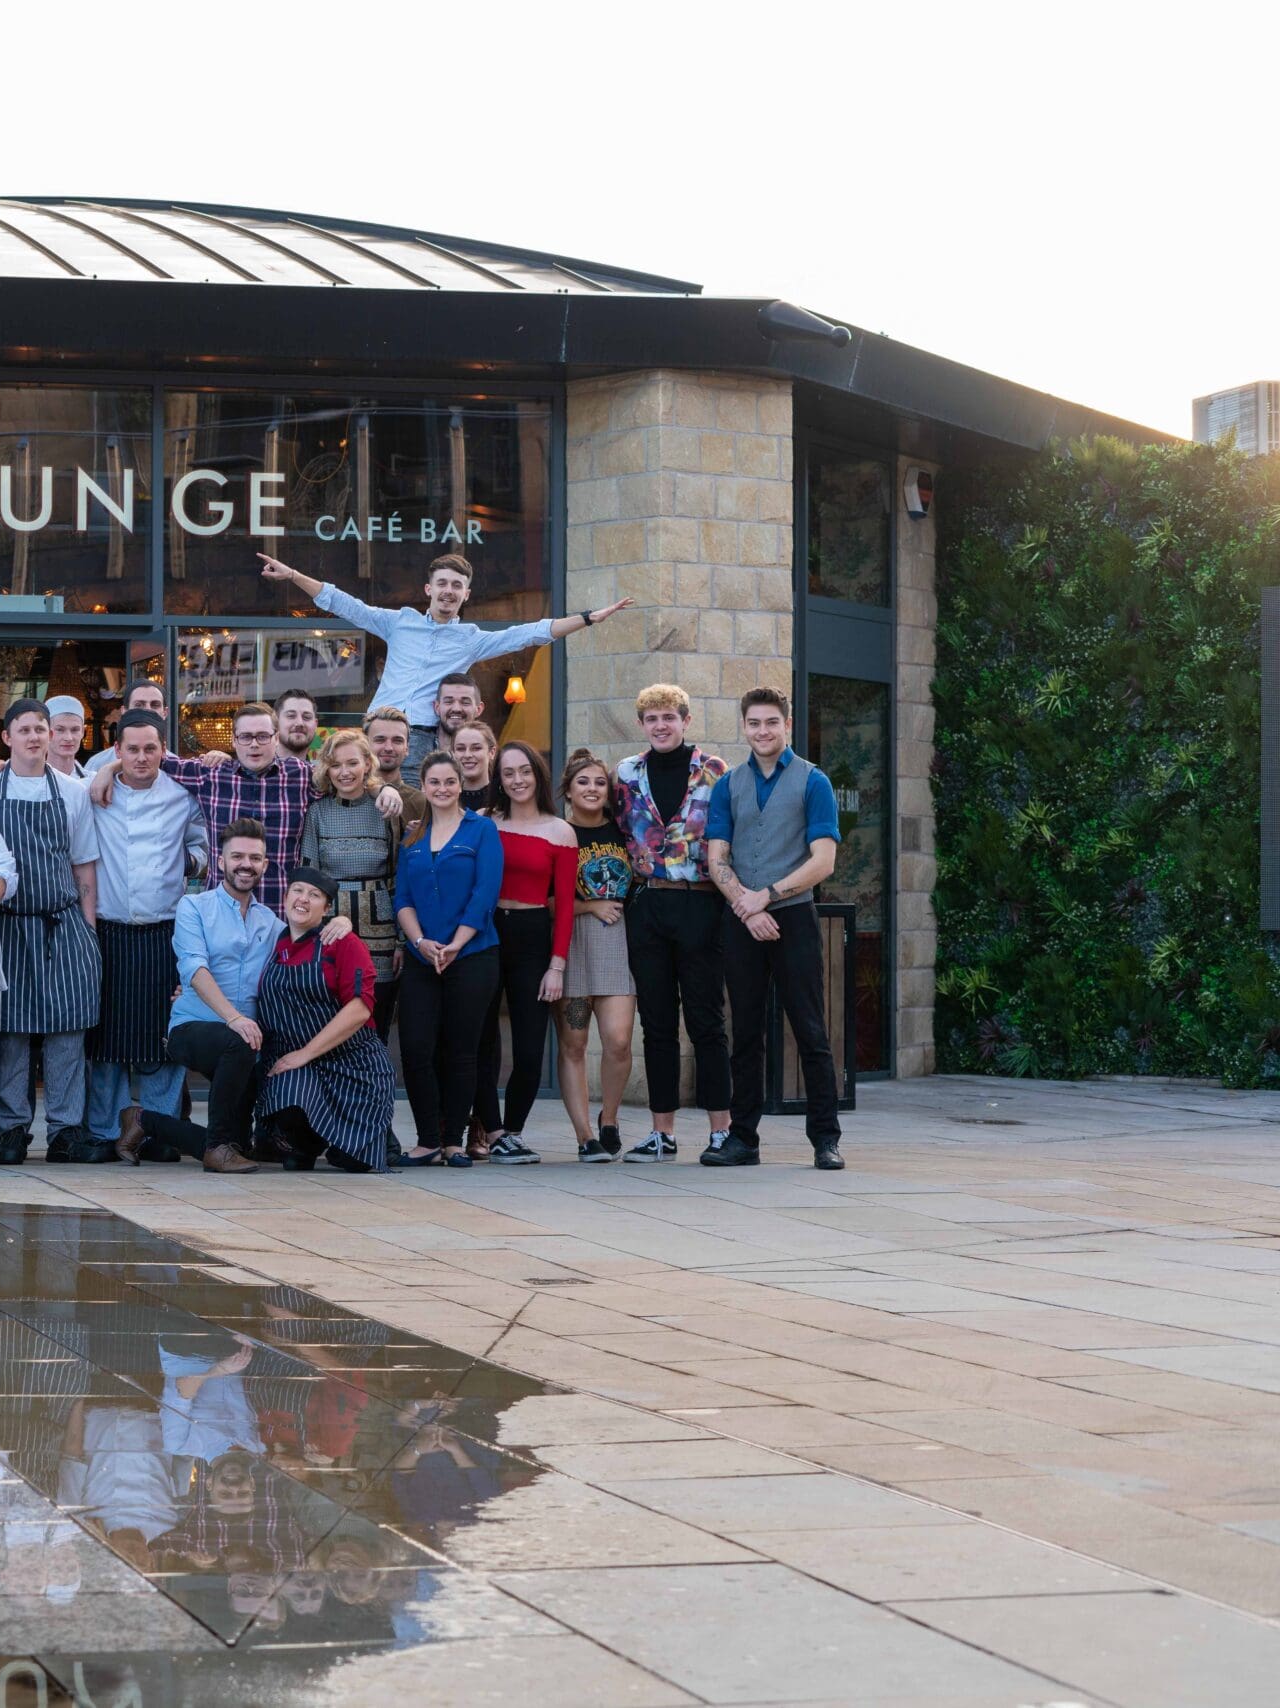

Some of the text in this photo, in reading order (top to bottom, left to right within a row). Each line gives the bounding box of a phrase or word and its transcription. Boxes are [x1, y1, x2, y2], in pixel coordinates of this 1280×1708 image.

[314, 510, 484, 545] CAFÉ BAR
[846, 790, 860, 812] BAR
